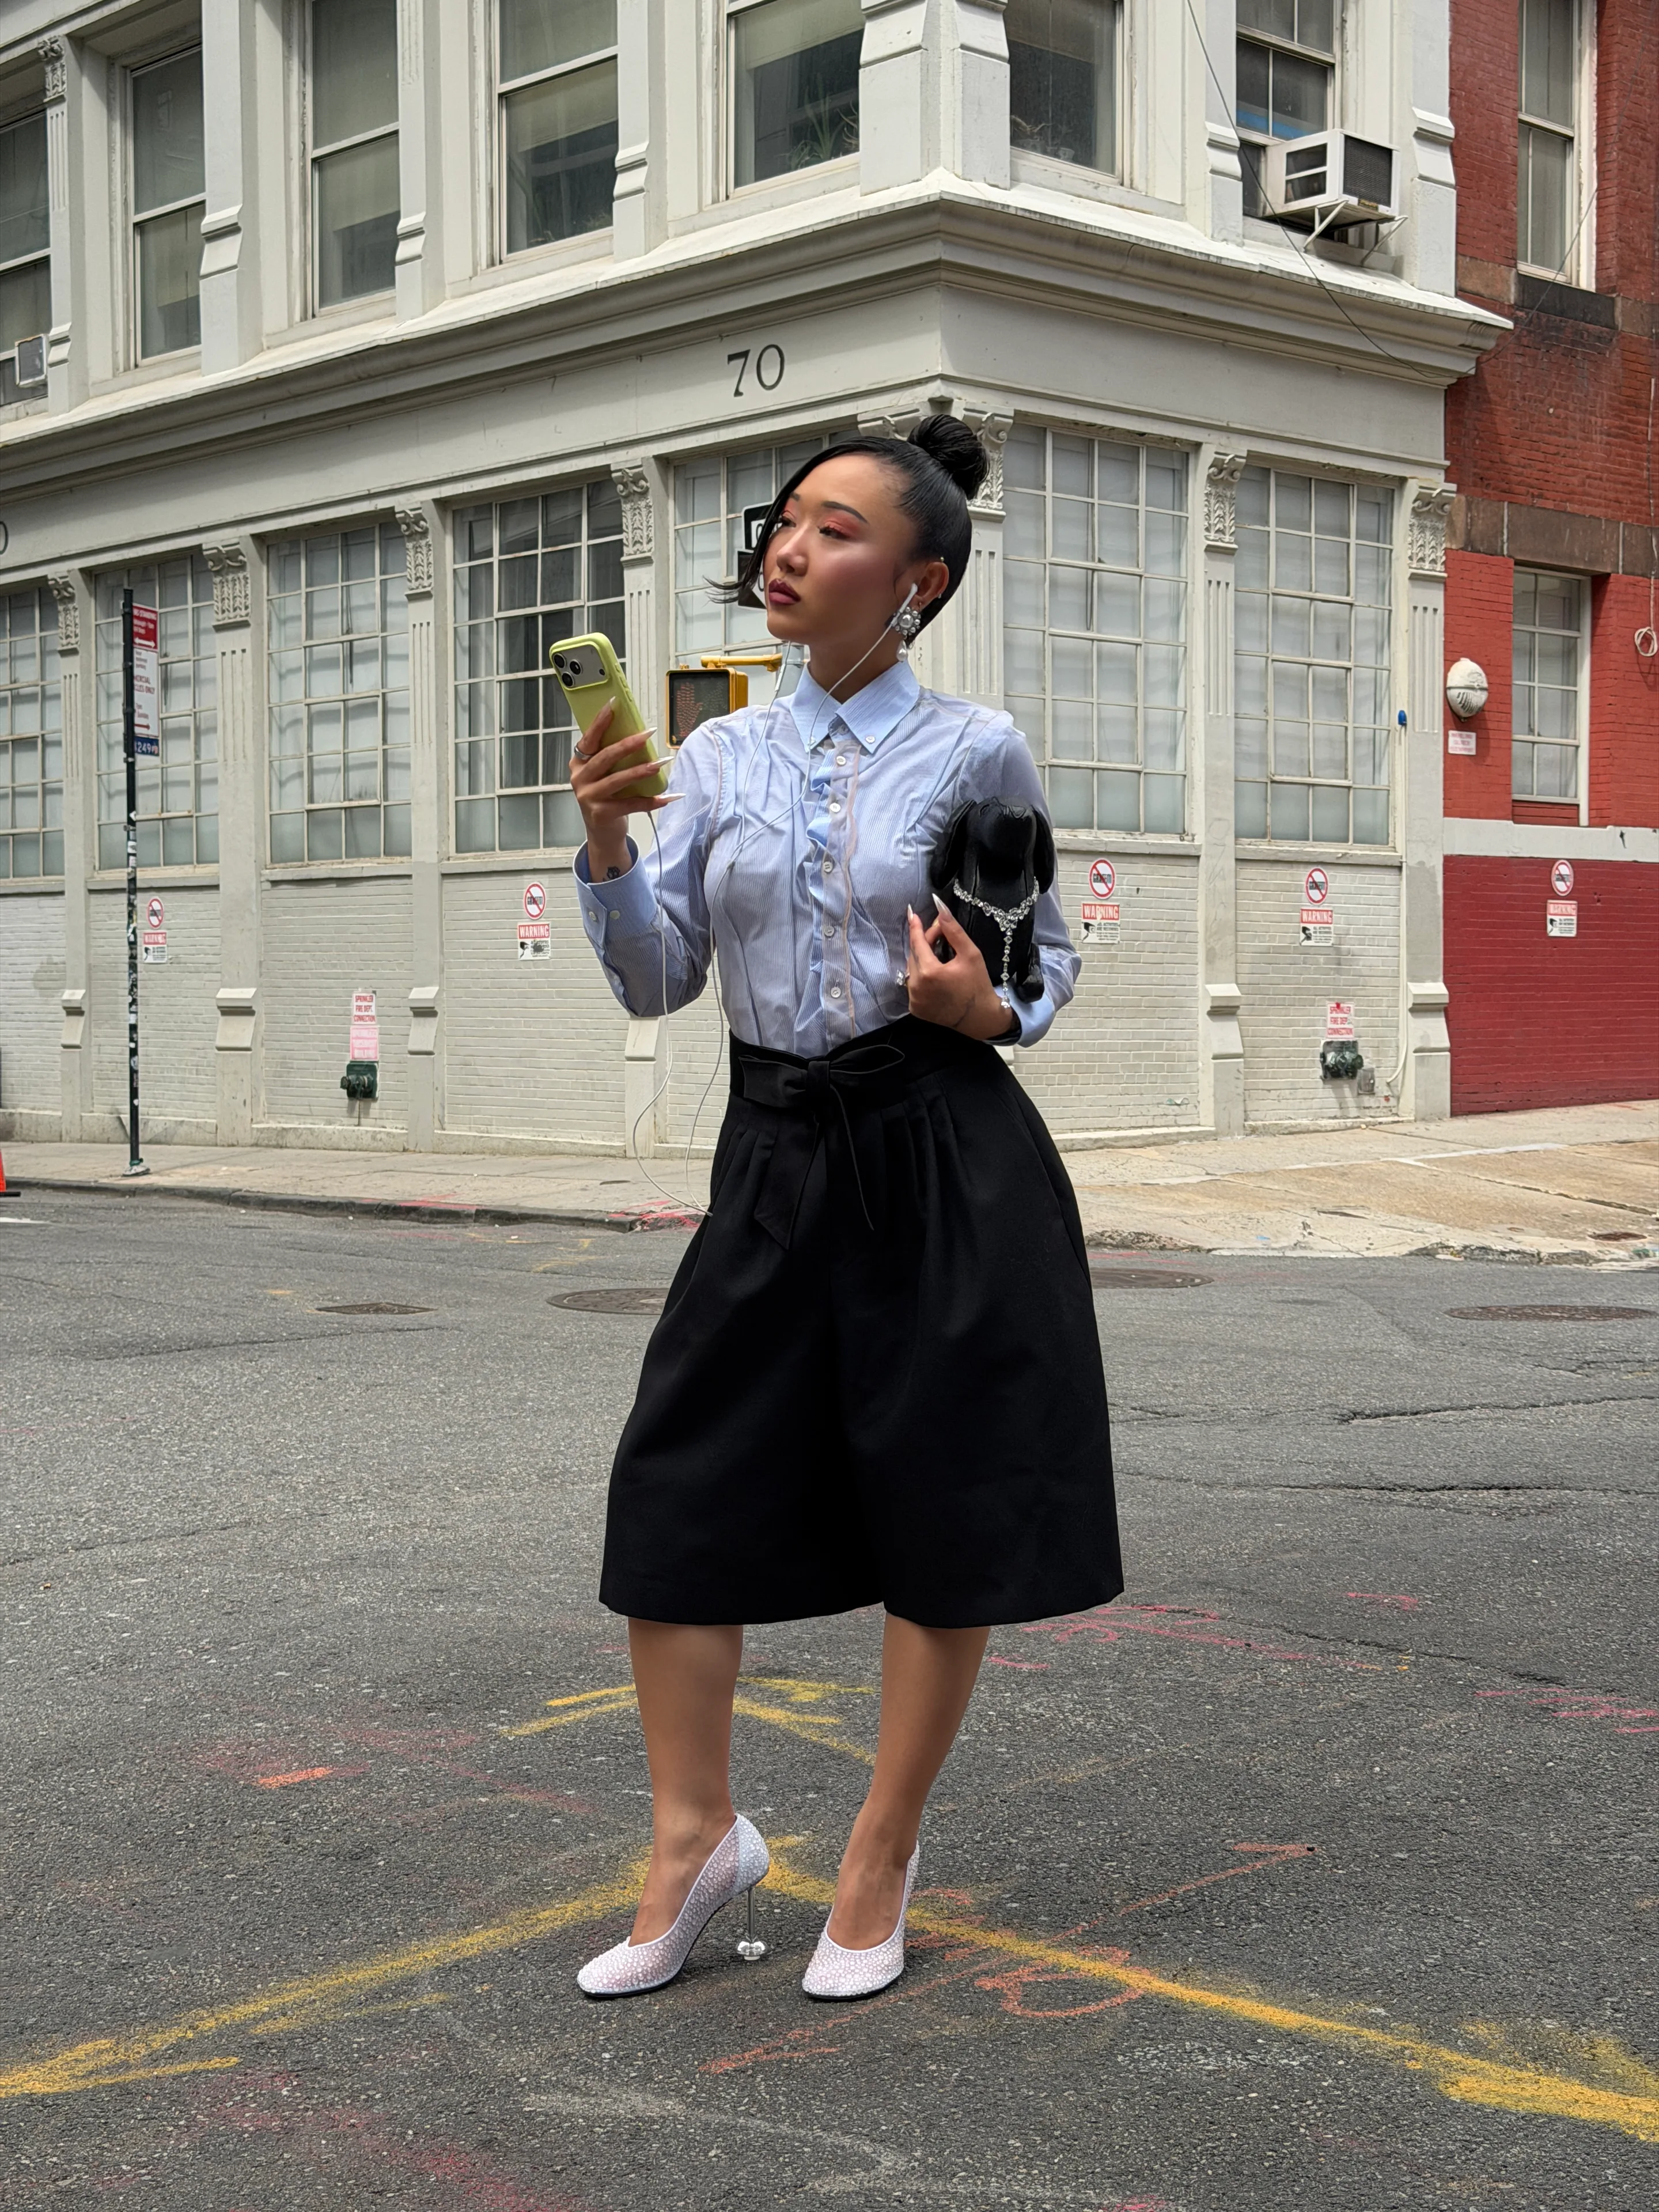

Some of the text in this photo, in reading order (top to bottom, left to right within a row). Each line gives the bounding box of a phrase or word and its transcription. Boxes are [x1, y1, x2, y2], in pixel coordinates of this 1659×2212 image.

[727, 344, 785, 397] 70
[1084, 905, 1119, 919] WARNING
[1302, 910, 1332, 923] WARNING
[520, 925, 549, 938] WARNING
